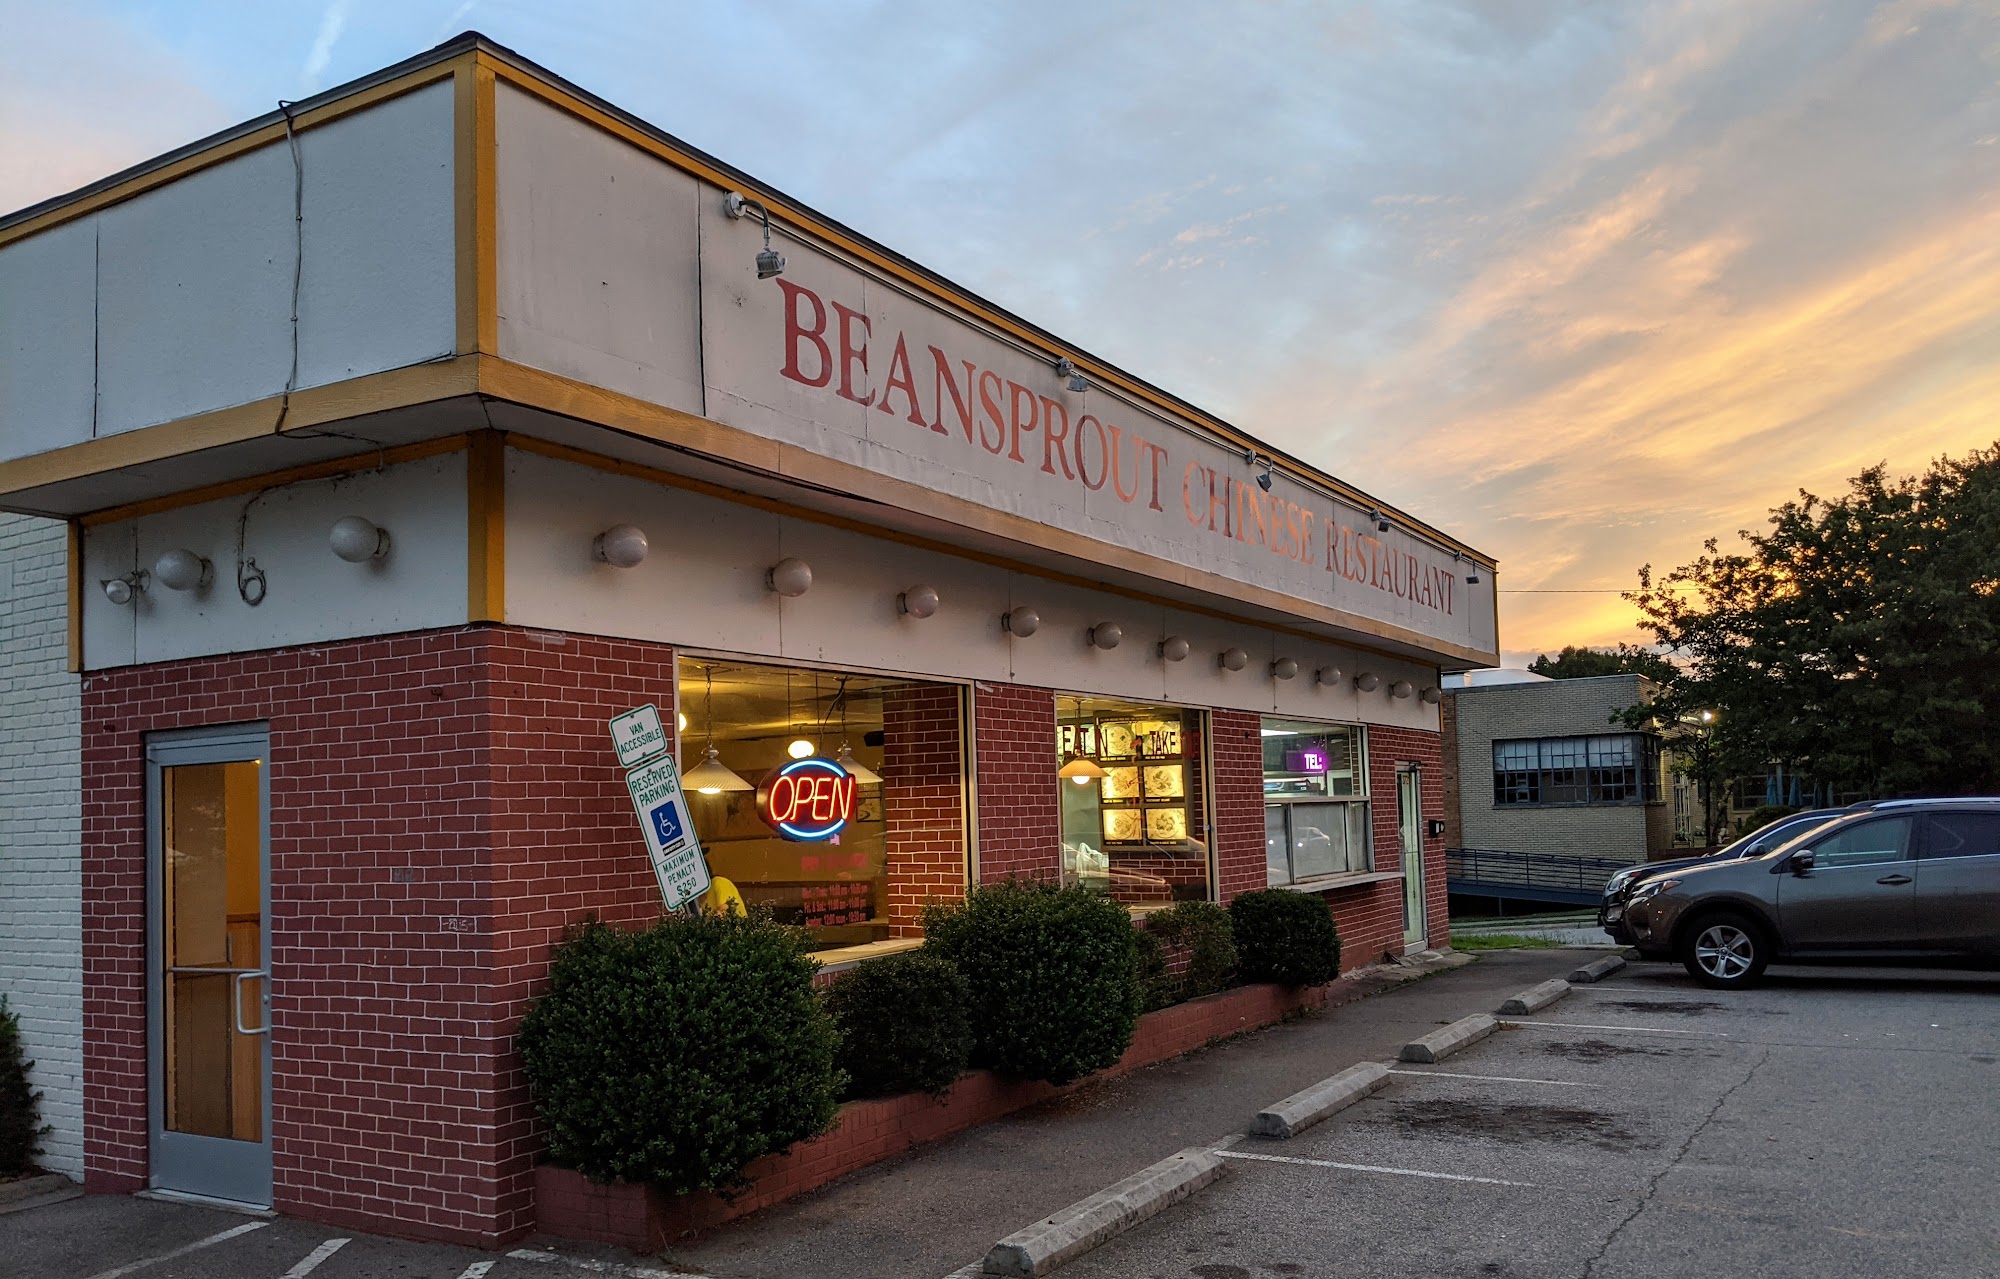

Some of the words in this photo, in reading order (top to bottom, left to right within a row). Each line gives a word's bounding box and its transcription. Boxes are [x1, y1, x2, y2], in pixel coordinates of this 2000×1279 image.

[776, 277, 1168, 512] BEANSPROUT
[1183, 461, 1315, 566] CHINESE
[1324, 518, 1455, 616] RESTAURANT
[620, 728, 661, 755] ACCESSIBLE
[629, 722, 644, 735] VAN
[1063, 727, 1089, 756] EAT
[1149, 731, 1176, 757] TAKE
[631, 765, 673, 794] RESERVED
[639, 780, 675, 807] PARKING
[770, 776, 852, 820] OPEN
[662, 848, 695, 874] MAXIMUM
[667, 861, 696, 885] PENALTY
[676, 877, 697, 897] $250
